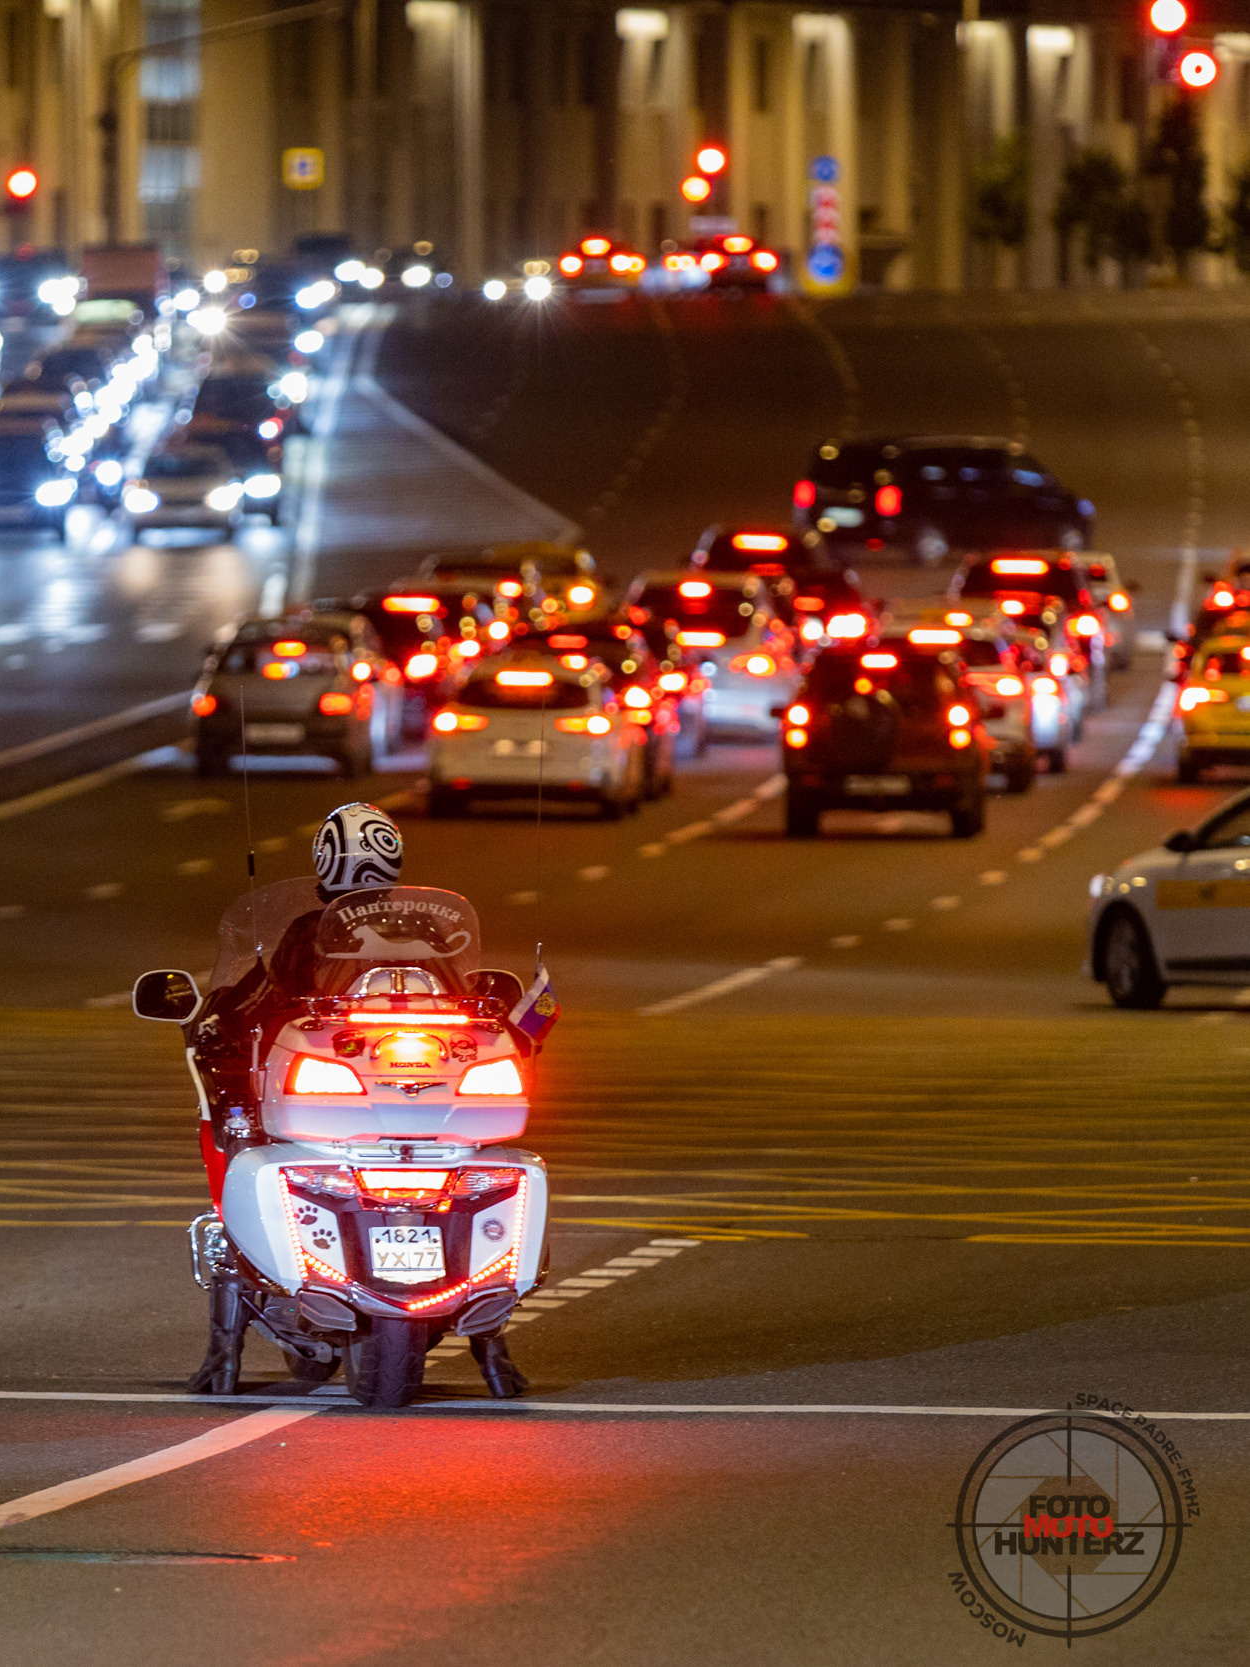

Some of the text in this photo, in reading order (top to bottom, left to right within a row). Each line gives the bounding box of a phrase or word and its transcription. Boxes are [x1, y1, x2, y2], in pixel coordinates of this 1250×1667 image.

[336, 900, 462, 923] Пантерочка
[389, 1061, 432, 1069] HONDA
[382, 1228, 432, 1244] 1821
[414, 1252, 438, 1267] 77
